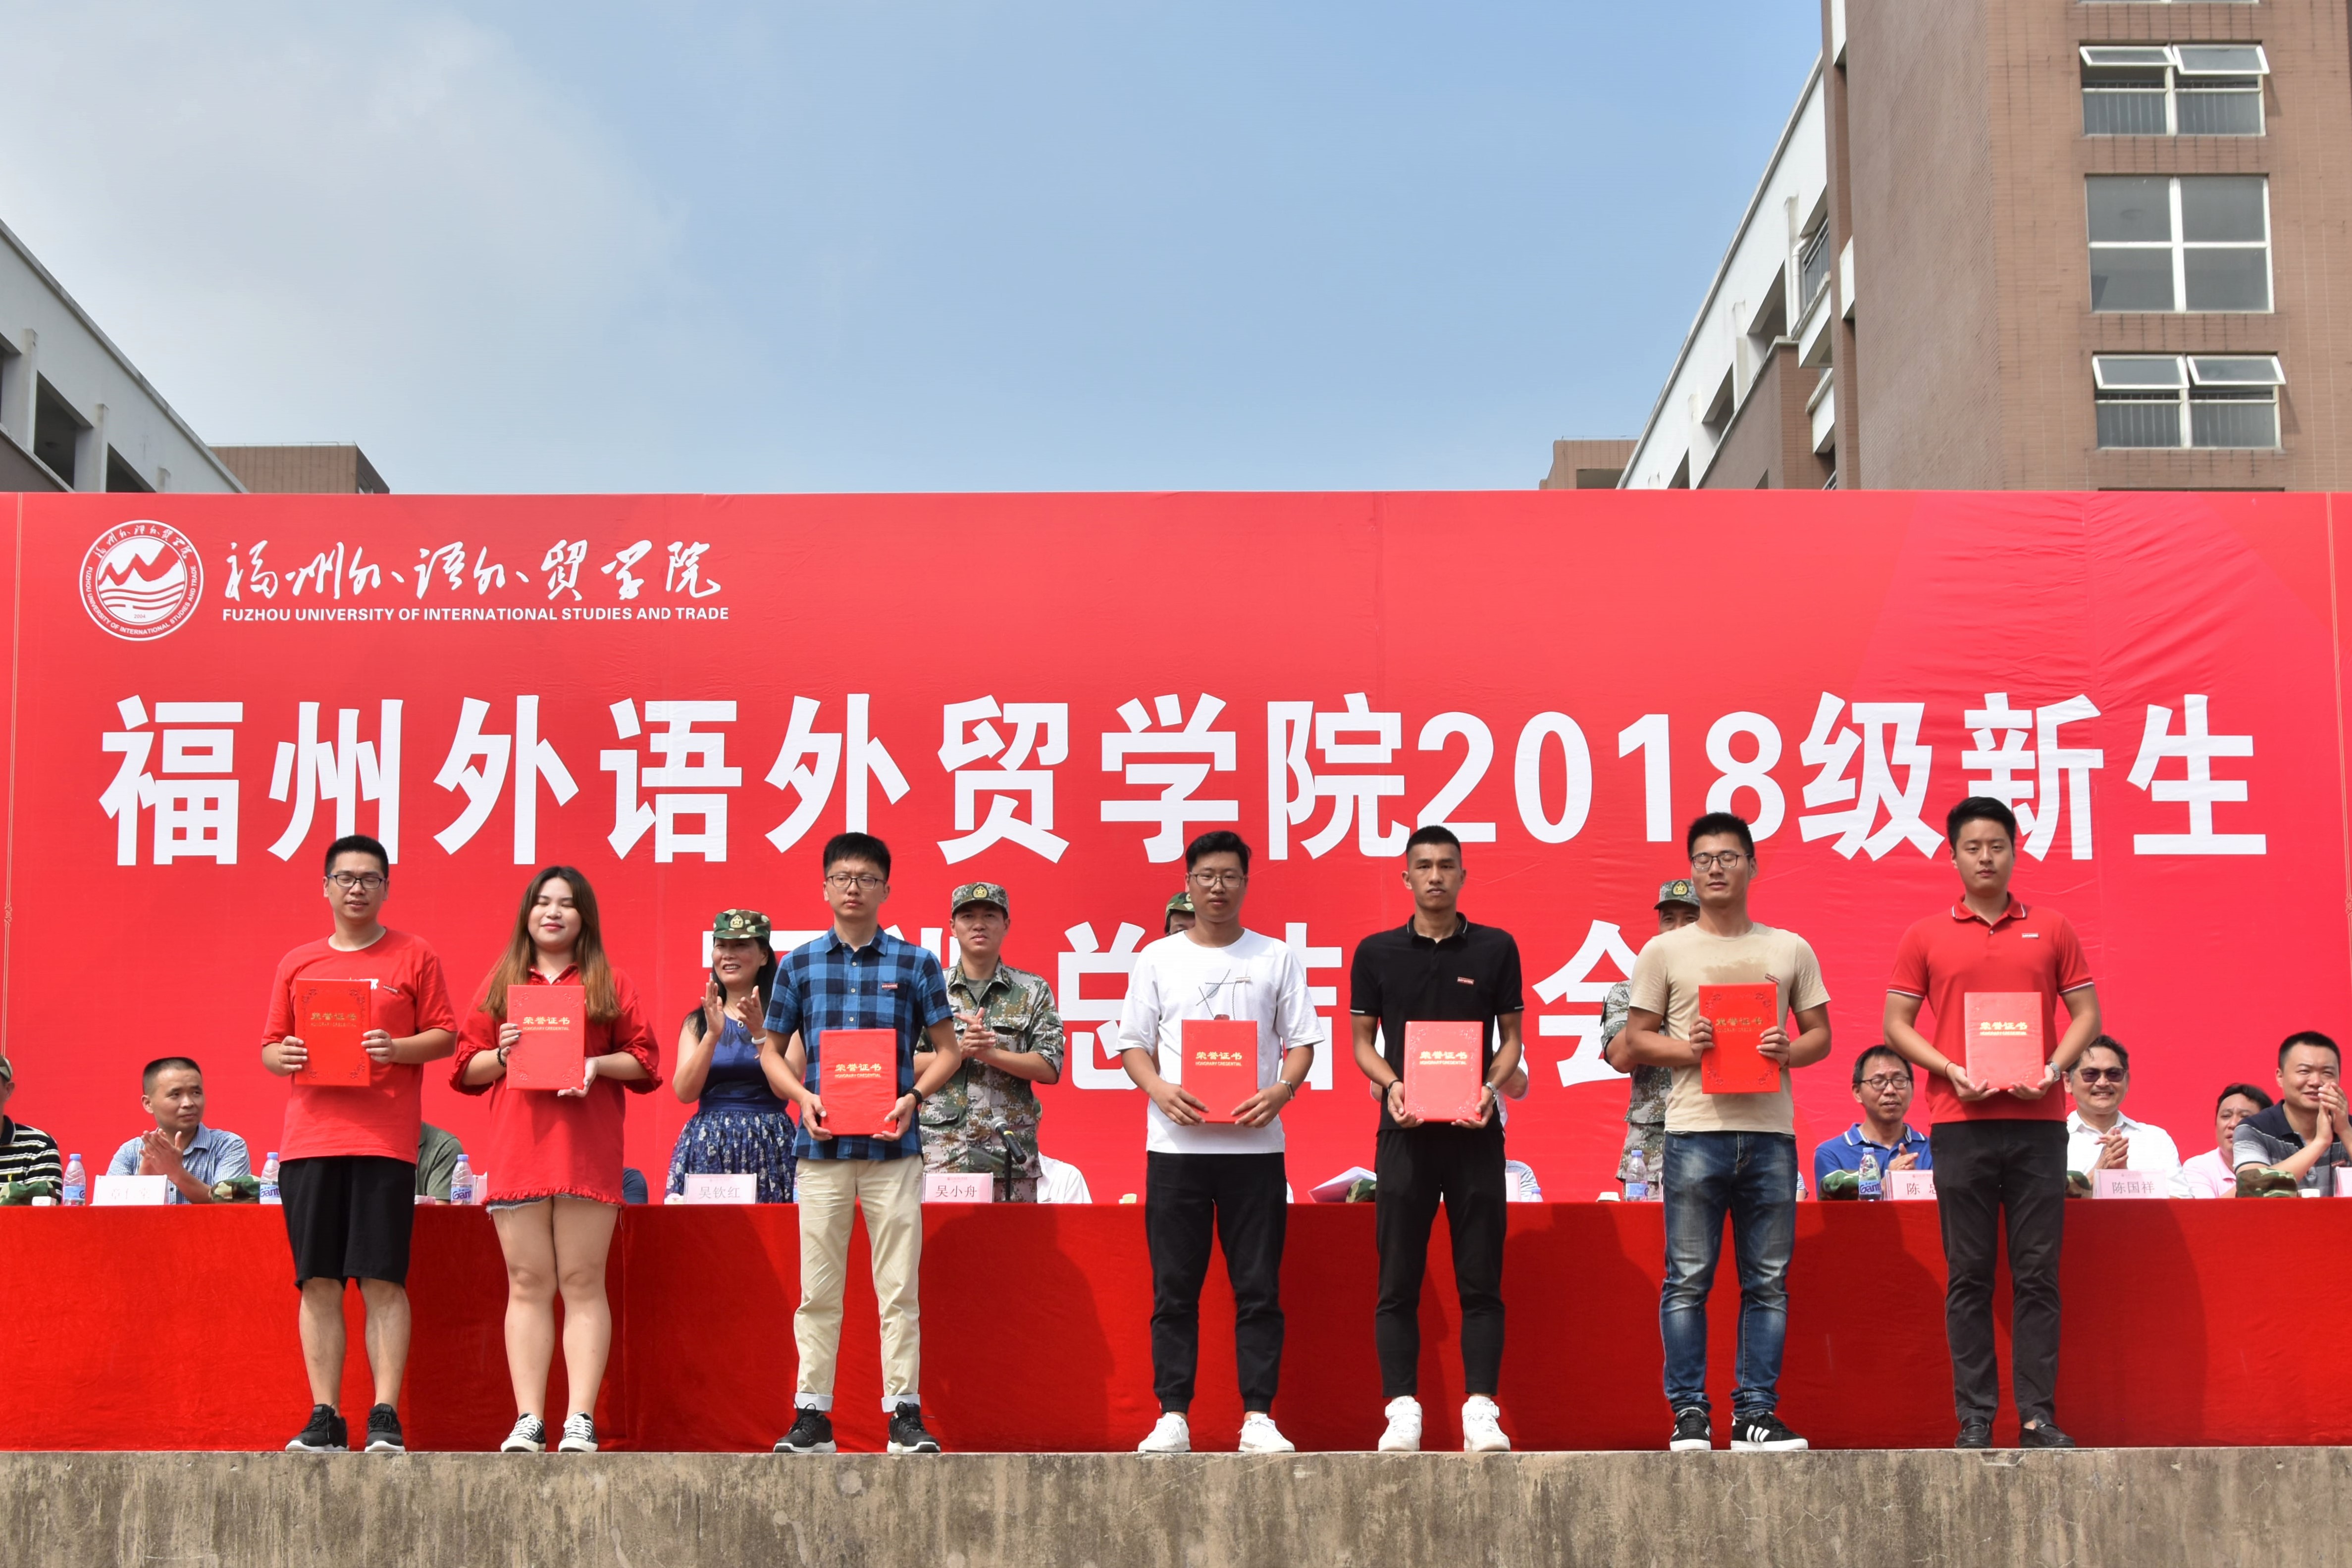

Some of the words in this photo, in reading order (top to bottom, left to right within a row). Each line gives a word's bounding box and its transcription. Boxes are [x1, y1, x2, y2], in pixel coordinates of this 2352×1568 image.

[87, 593, 111, 624] UNIVERSITY
[120, 622, 170, 635] INTERNATIONAL
[170, 602, 191, 624] STUDIES
[223, 608, 291, 621] FUZHOU
[295, 608, 394, 621] UNIVERSITY
[398, 608, 420, 621] OF
[424, 607, 558, 620] INTERNATIONAL
[562, 607, 632, 620] STUDIES
[636, 607, 671, 620] AND
[675, 607, 729, 620] TRADE
[99, 692, 2268, 866] 福州外语外贸学院2018级新生
[523, 1016, 570, 1025] 荣誉证书
[1196, 1051, 1243, 1060] 荣誉证书
[835, 1063, 882, 1072] 荣誉证书
[699, 1186, 740, 1199] 吴钦红
[935, 1185, 977, 1198] 吴小舟
[2112, 1181, 2155, 1194] 陈国祥
